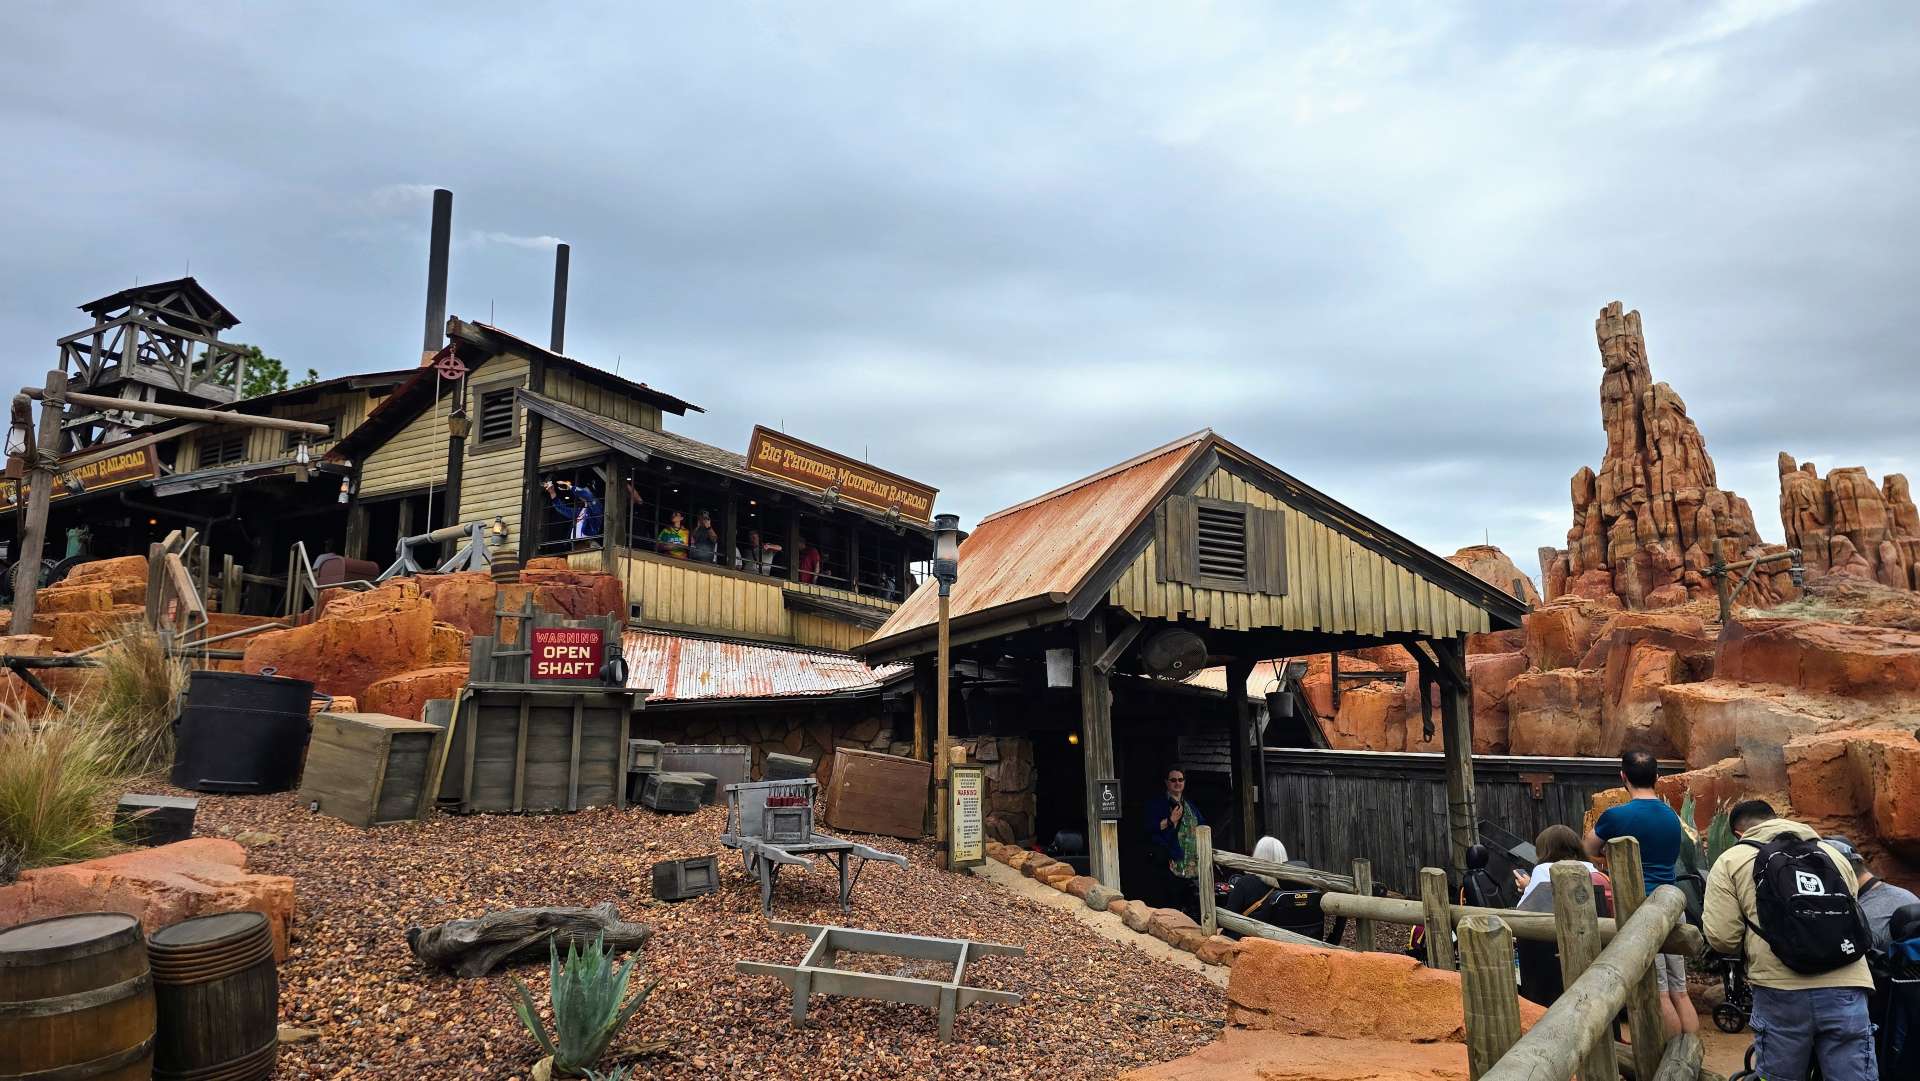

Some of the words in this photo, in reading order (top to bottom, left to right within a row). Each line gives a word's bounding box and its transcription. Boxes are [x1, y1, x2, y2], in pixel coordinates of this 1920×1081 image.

[99, 450, 146, 477] RAILROAD
[758, 441, 782, 463] BIG
[783, 450, 836, 481] THUNDER
[837, 467, 890, 498] MOUNTAIN
[887, 485, 928, 511] RAILROAD
[536, 632, 599, 644] WARNING
[543, 646, 591, 659] OPEN
[537, 662, 595, 675] SHAFT
